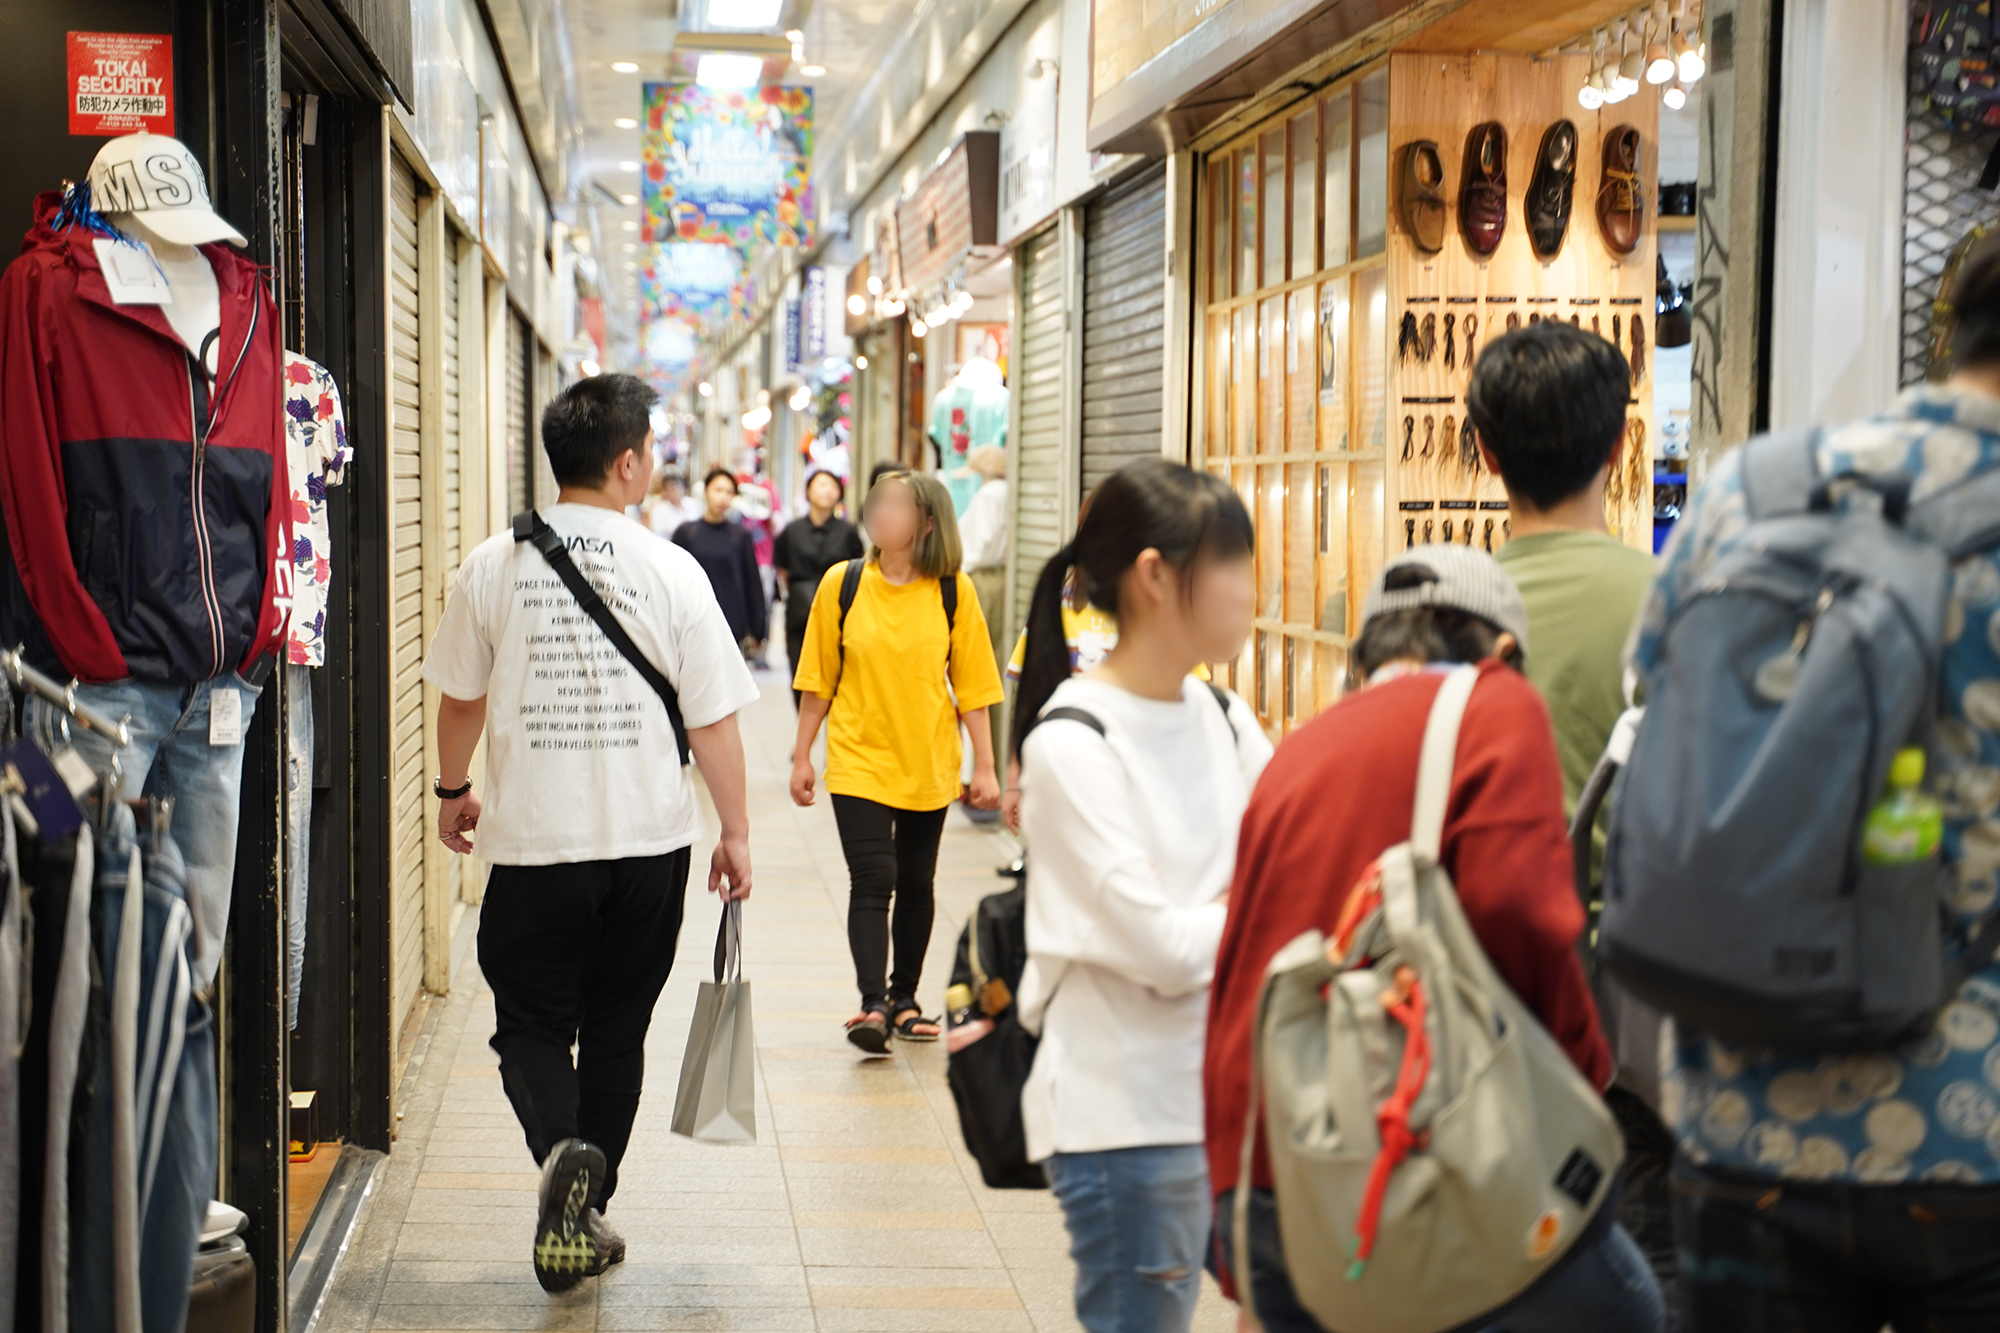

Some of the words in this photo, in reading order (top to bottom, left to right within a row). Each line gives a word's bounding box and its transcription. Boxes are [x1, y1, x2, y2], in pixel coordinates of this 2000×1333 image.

[94, 59, 147, 77] TOKAI
[78, 76, 163, 94] SECURITY
[79, 96, 164, 114] 防犯カメラ作動中
[664, 140, 785, 186] Summer
[513, 579, 538, 591] SPACE
[523, 597, 544, 609] APRIL
[525, 634, 553, 646] LAUNCH
[534, 669, 569, 681] ROLLOUT
[519, 703, 541, 716] ORBIT
[525, 720, 548, 732] ORBIT
[530, 738, 553, 750] MILES
